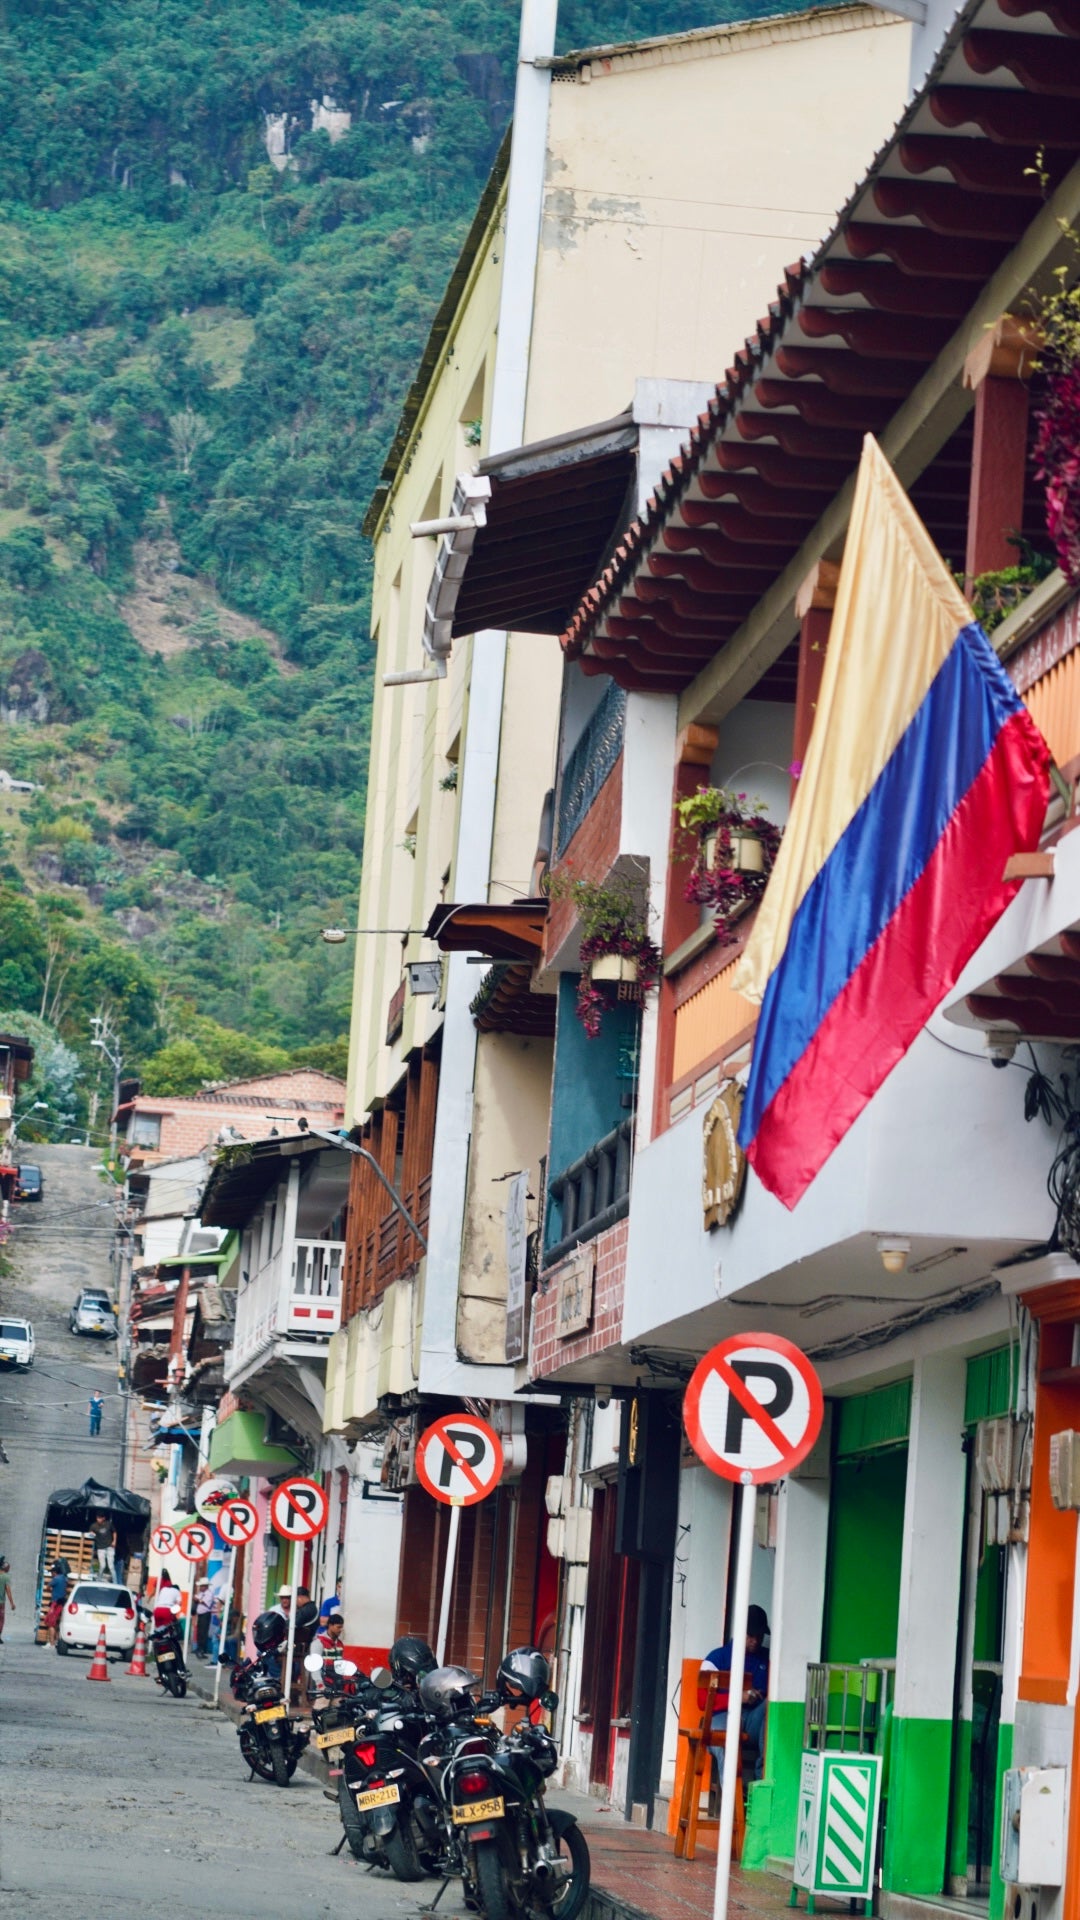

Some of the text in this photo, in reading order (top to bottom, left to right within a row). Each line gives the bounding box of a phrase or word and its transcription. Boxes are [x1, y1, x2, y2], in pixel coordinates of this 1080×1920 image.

[724, 1360, 793, 1454] P
[439, 1429, 485, 1487] P
[229, 1507, 250, 1536] P
[287, 1489, 316, 1528] P
[158, 1531, 172, 1549] P
[187, 1531, 205, 1554] P
